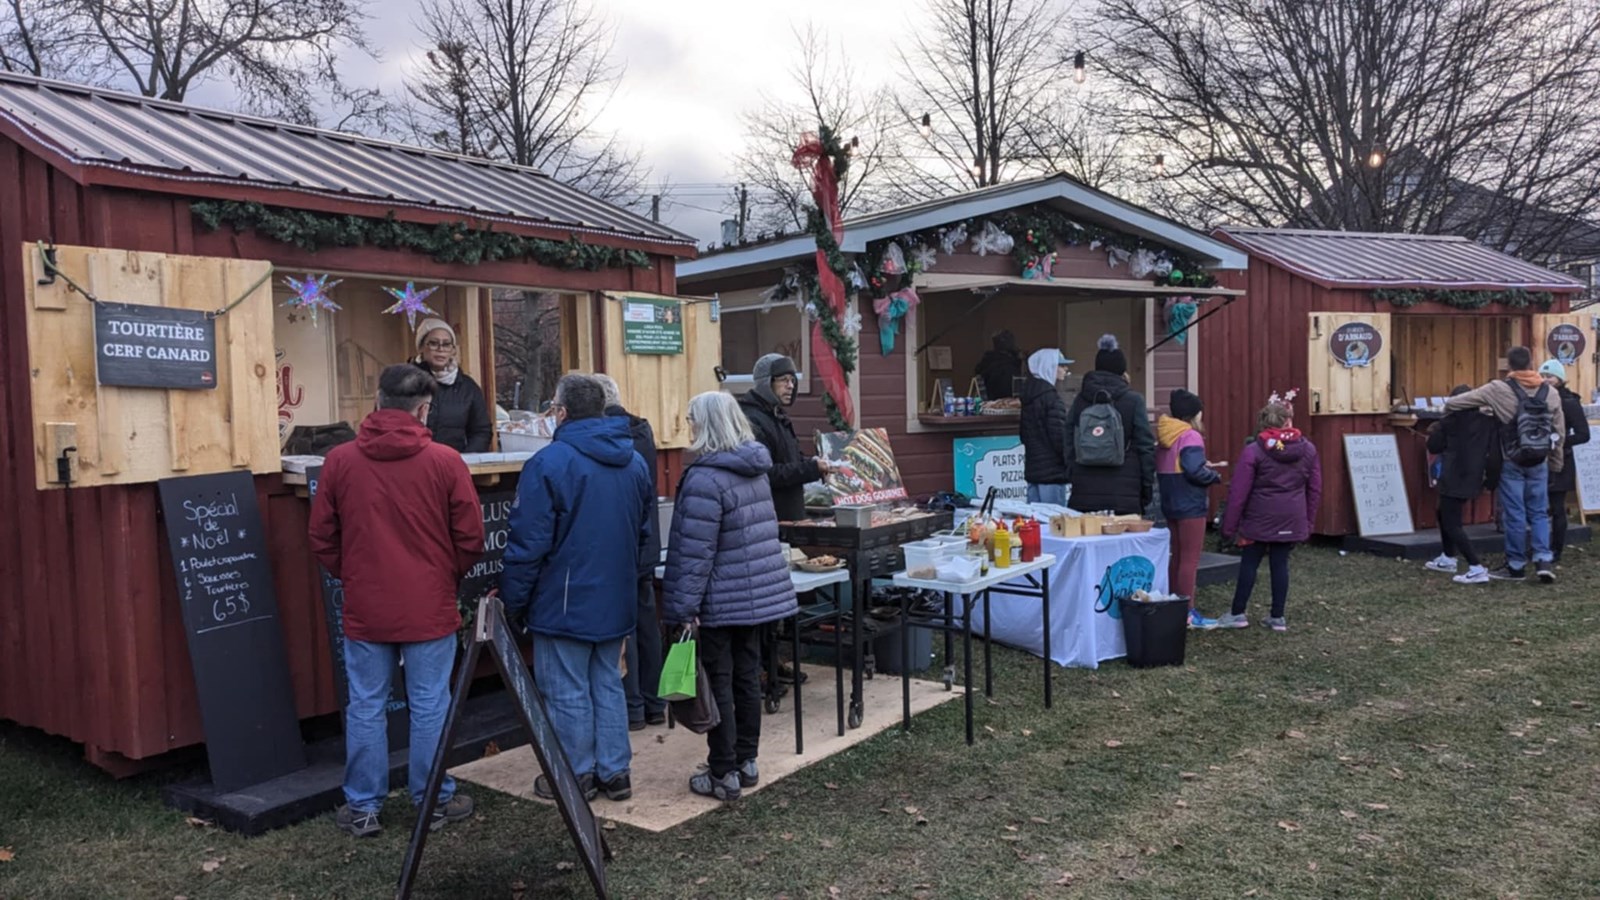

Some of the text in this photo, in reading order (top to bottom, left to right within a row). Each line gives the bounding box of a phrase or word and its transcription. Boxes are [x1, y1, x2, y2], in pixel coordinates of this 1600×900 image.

[108, 320, 205, 341] TOURTIÈRE
[103, 343, 210, 362] CERF CANARD
[993, 454, 1025, 467] PLATS P
[837, 495, 854, 505] HOT
[855, 492, 872, 504] DOG
[995, 486, 1028, 499] ANDWIC
[183, 493, 239, 526] Spécial
[480, 500, 511, 523] LUS
[204, 518, 220, 532] de
[192, 528, 229, 550] Noël
[484, 528, 512, 551] MO
[464, 559, 505, 579] OPLUS
